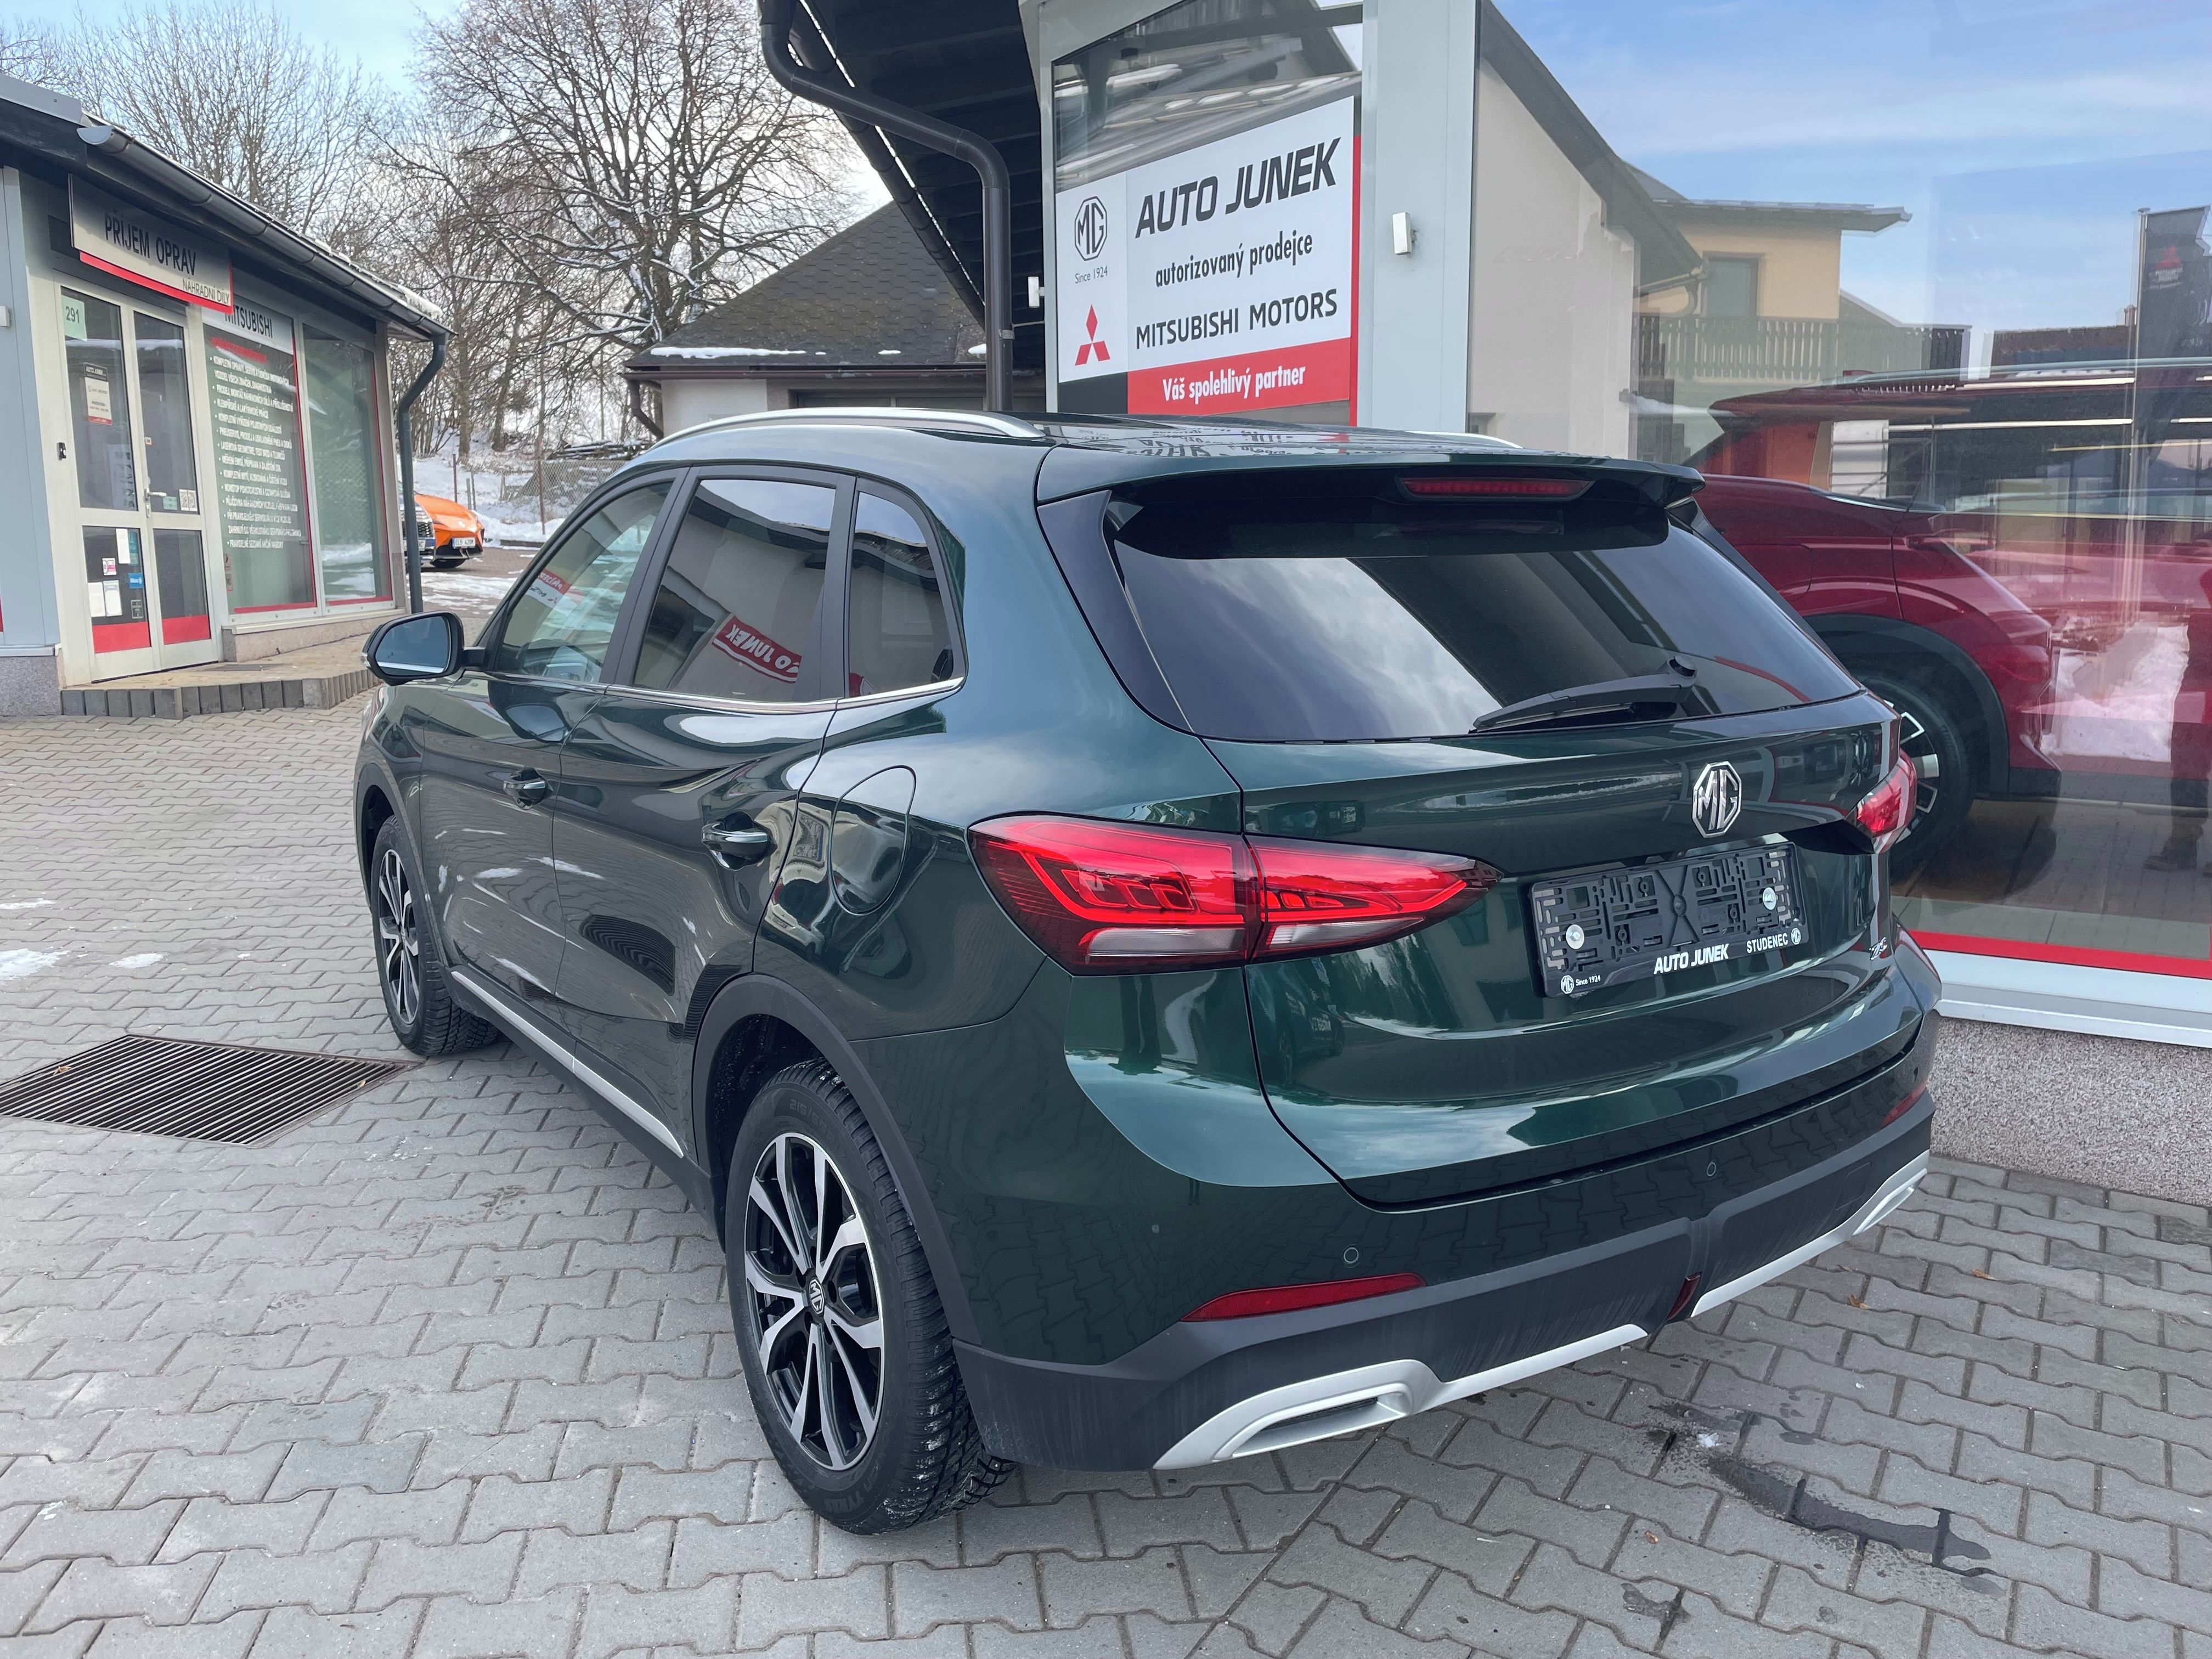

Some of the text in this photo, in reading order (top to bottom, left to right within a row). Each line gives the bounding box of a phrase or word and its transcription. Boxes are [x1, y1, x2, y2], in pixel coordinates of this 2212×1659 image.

[1135, 137, 1341, 239] AUTO JUNEK
[104, 208, 196, 275] PŘÍJEM OPRAV
[1077, 201, 1105, 256] MG
[1075, 266, 1108, 284] Since 1924
[1155, 229, 1312, 287] autorizovaný prodejce
[182, 277, 229, 304] NÁHRADNÍ DÍLY
[65, 306, 80, 324] 291
[1136, 288, 1337, 349] MITSUBISHI MOTORS
[1163, 365, 1306, 405] Váš spolehlivý partner
[1697, 768, 1738, 831] MG
[1654, 928, 1801, 975] AUTO JUNEK STUDENEC MG
[1561, 976, 1573, 993] MG
[1589, 974, 1601, 983] 1924
[810, 1283, 823, 1311] MG
